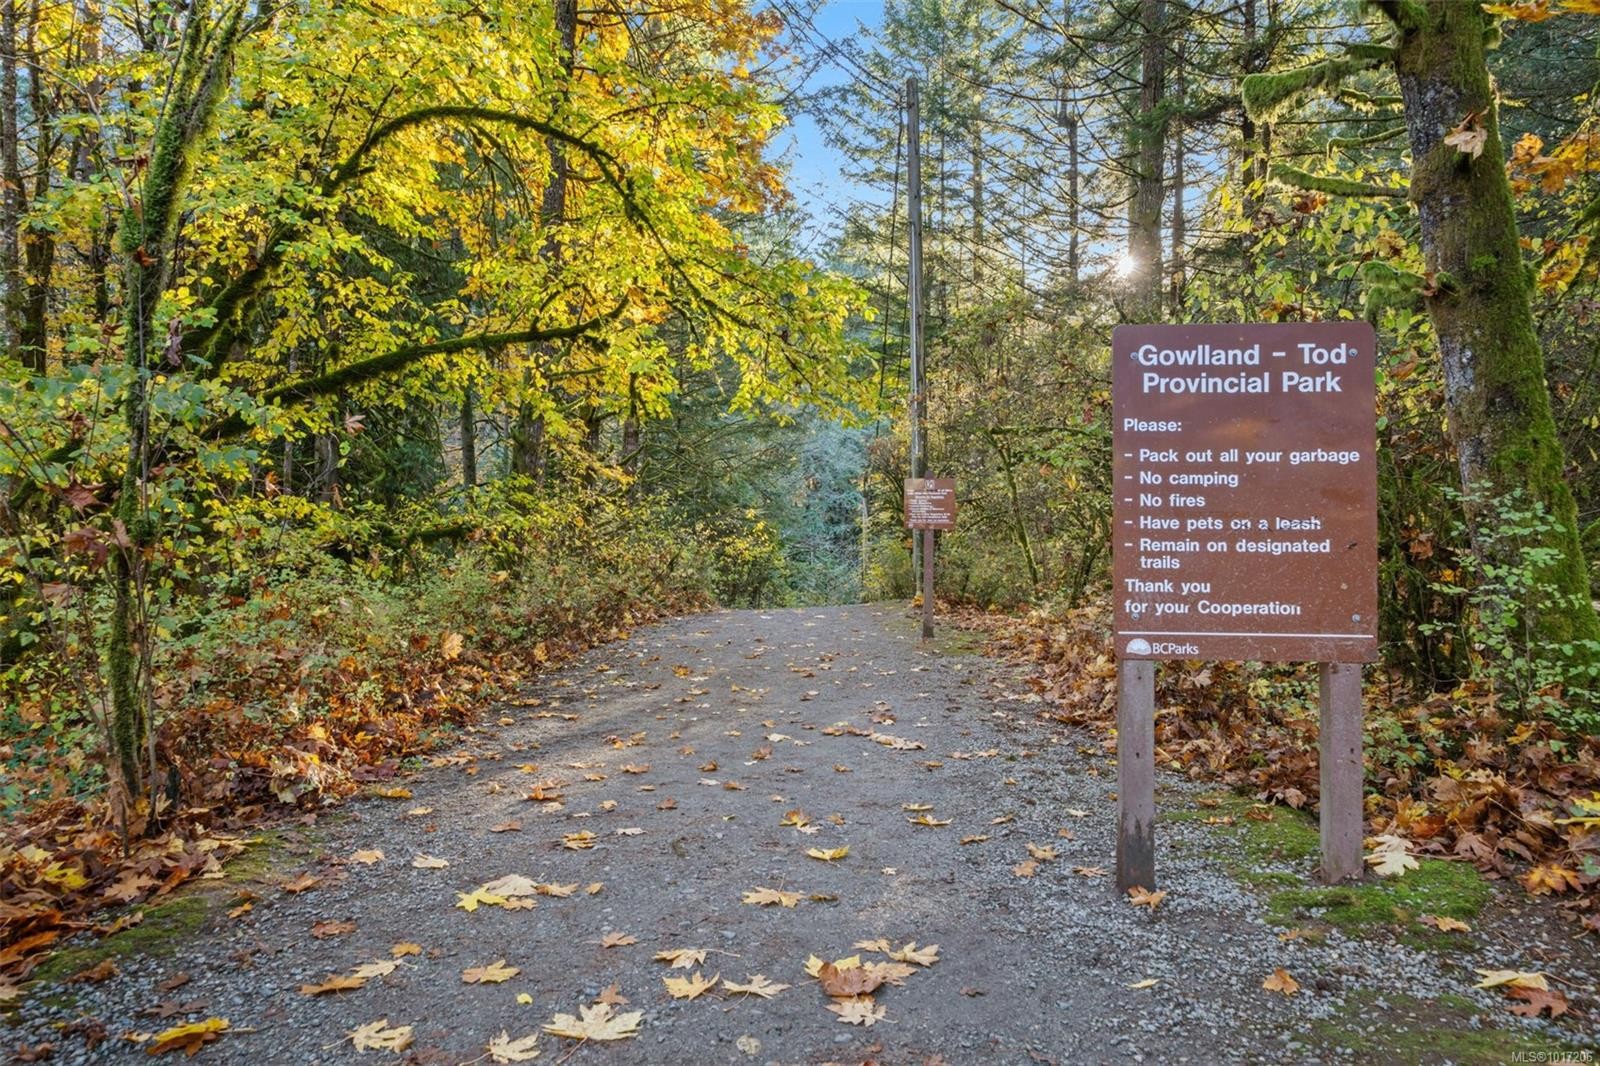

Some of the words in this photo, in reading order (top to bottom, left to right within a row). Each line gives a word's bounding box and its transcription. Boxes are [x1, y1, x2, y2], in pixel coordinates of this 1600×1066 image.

[1138, 344, 1260, 366] Gowlland
[1298, 343, 1347, 365] Tod
[1143, 372, 1270, 394] Provincial
[1282, 371, 1342, 392] Park
[1124, 418, 1182, 432] Please:
[1140, 449, 1178, 462] Pack
[1186, 450, 1212, 462] out
[1220, 449, 1238, 462] all
[1246, 452, 1282, 464] your
[1290, 449, 1360, 465] garbage
[1140, 472, 1162, 484] No
[1169, 472, 1238, 487] camping
[1140, 494, 1162, 507] No
[1170, 494, 1205, 507] fires
[1140, 516, 1180, 529] Have
[1187, 518, 1223, 532] pets
[1230, 519, 1251, 529] on
[1259, 520, 1268, 530] a
[1276, 517, 1321, 530] leash
[1140, 538, 1200, 552] Remain
[1207, 542, 1227, 552] on
[1236, 539, 1330, 555] designated
[1140, 555, 1180, 569] trails
[1125, 579, 1173, 592] Thank
[1182, 583, 1211, 595] you
[1125, 600, 1148, 613] for
[1155, 604, 1189, 616] your
[1198, 601, 1301, 617] Cooperation
